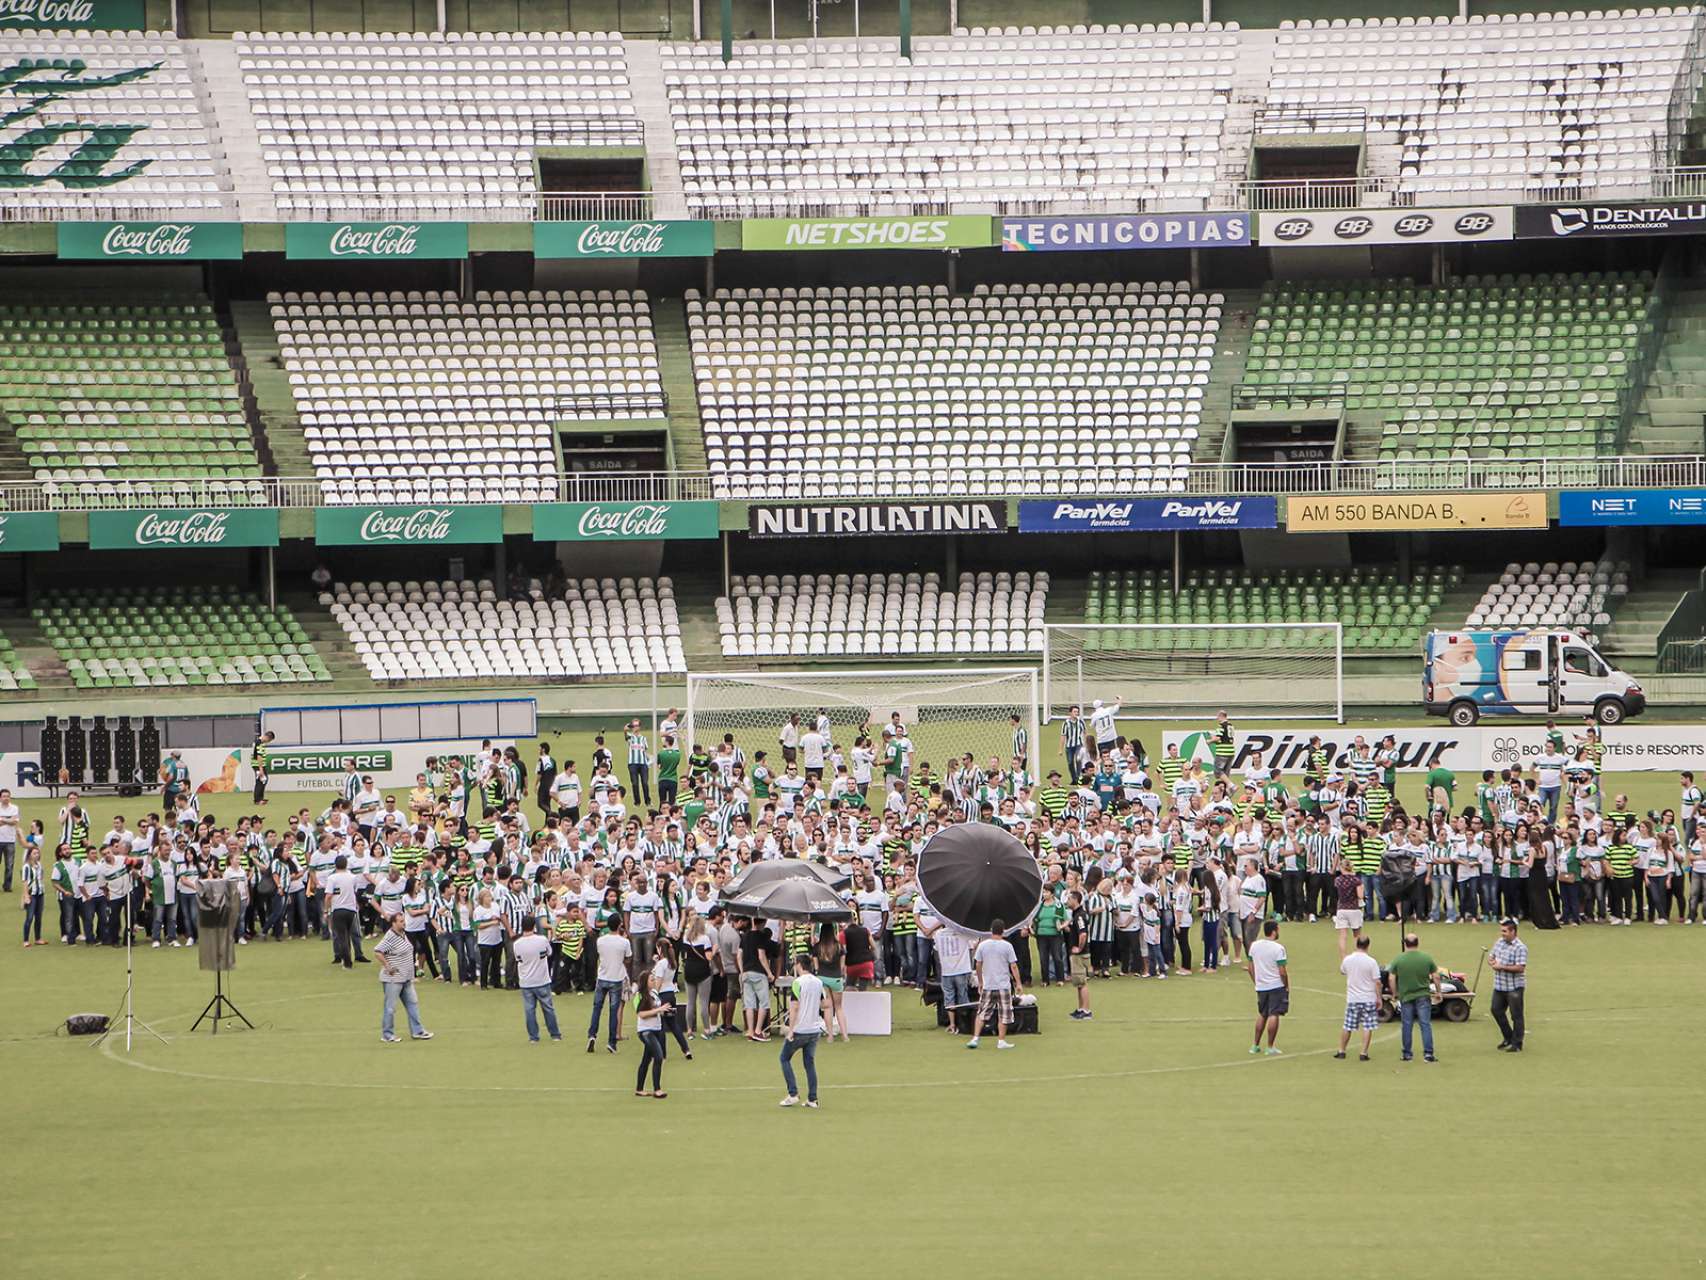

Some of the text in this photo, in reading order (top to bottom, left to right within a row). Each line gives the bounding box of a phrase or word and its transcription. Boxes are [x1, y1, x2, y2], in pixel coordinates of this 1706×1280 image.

[102, 224, 195, 255] Coca-Cola
[330, 224, 420, 256] Coca-Cola
[578, 223, 667, 254] Coca-Cola
[785, 220, 949, 245] NETSHOES
[1004, 218, 1245, 245] TECNICÓPIAS
[1301, 505, 1329, 521] AM
[1335, 504, 1367, 521] 550
[1372, 504, 1437, 520] BANDA
[1592, 499, 1637, 511] NET
[1669, 498, 1706, 511] NE
[135, 512, 231, 544] Coca-Cola
[361, 509, 454, 541] Coca-Cola
[578, 505, 670, 537] Coca-Cola
[757, 504, 998, 534] NUTRILATINA
[1636, 744, 1645, 755] &
[1647, 744, 1704, 755] RESORTS
[297, 780, 334, 788] FUTEBOL
